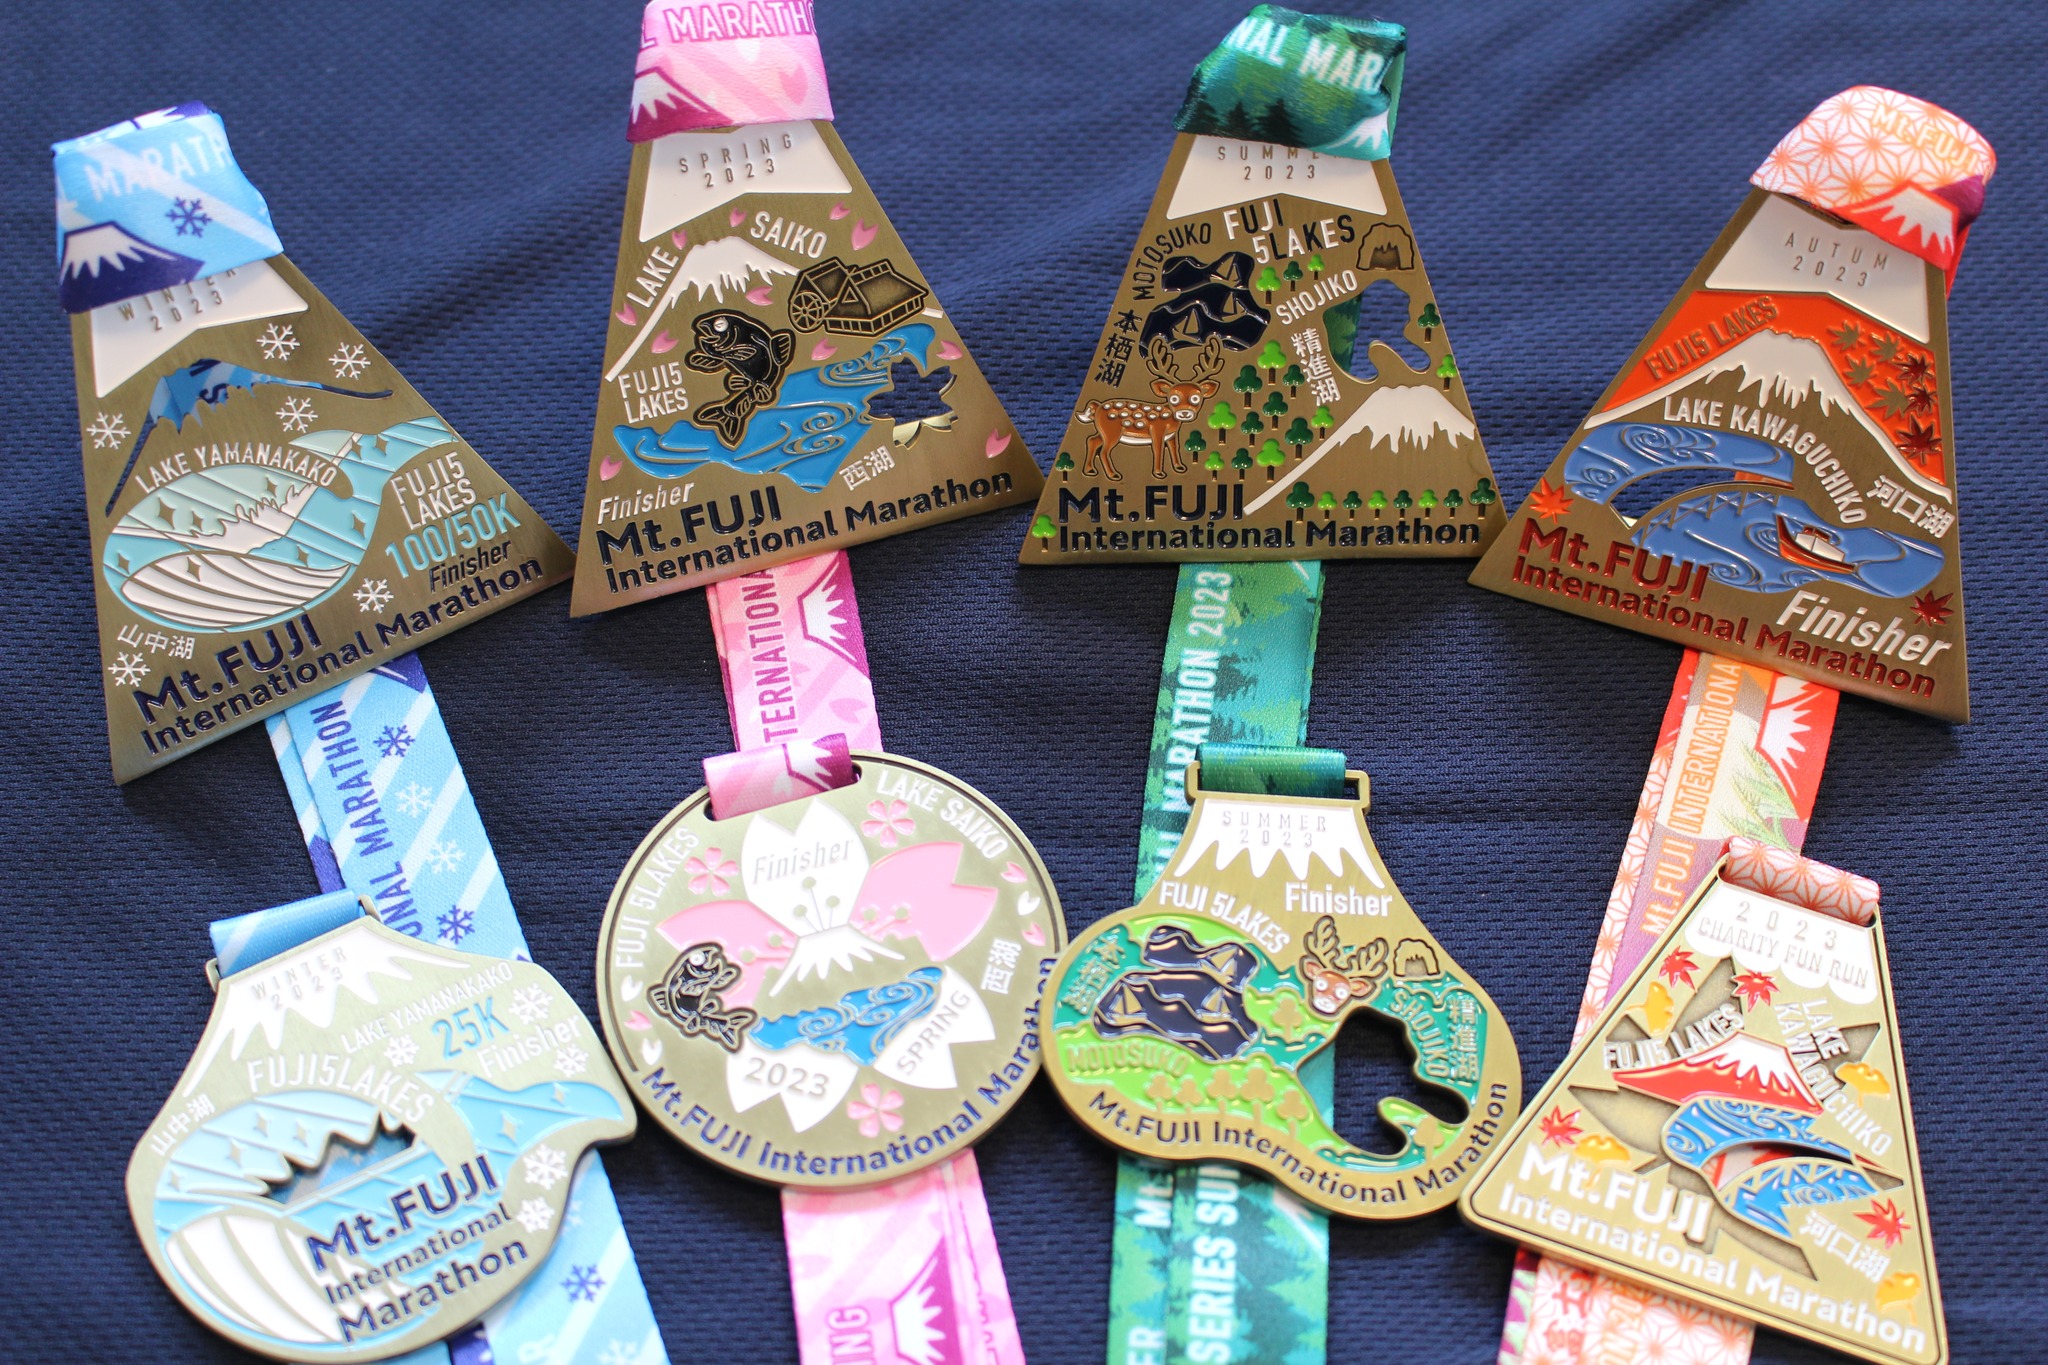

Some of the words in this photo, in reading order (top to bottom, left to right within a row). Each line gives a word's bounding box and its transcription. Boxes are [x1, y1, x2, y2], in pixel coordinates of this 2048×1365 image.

[84, 132, 234, 202] MARATH
[679, 133, 792, 174] SPRING
[1870, 104, 1980, 171] Mt.FUJI
[704, 158, 775, 189] 2023
[1244, 165, 1316, 181] 2023
[1223, 198, 1284, 240] FUJI
[1252, 214, 1356, 264] 5LAKES
[1784, 232, 1889, 271] AUTUM
[627, 245, 680, 308] LAKE
[750, 211, 828, 259] SAIKO
[1132, 222, 1212, 301] MOTOSUKO
[1793, 256, 1869, 287] 2023
[150, 290, 223, 332] 2023
[1275, 269, 1358, 326] SHOJIKO
[1708, 295, 1779, 346] LAKES
[1094, 309, 1143, 389] 本栖湖
[1290, 327, 1342, 407] 精進湖
[624, 387, 690, 425] LAKES
[135, 452, 191, 494] LAKE
[194, 442, 338, 488] YAMANAKAKO
[838, 445, 896, 491] 西湖
[1663, 395, 1724, 428] LAKE
[1729, 404, 1868, 524] KAWAGUCHIKO
[385, 492, 522, 579] 100/50K
[400, 478, 476, 531] LAKES
[596, 485, 782, 566] Mt.FUJI
[597, 481, 694, 525] Finisher
[605, 510, 838, 593] International
[844, 471, 1013, 532] Marathon
[1058, 483, 1244, 524] Mt.FUJI
[1060, 520, 1296, 552] International
[1305, 517, 1481, 548] Marathon
[1866, 474, 1956, 539] 河口湖
[429, 538, 512, 594] Finisher
[1517, 516, 1710, 603] Mt.FUJI
[1186, 570, 1233, 639] 2023
[1512, 555, 1750, 646] International
[1754, 623, 1936, 699] Marathon
[1775, 589, 1953, 667] Finisher
[117, 623, 196, 660] 山中湖
[132, 612, 322, 726] Mt.FUJI
[140, 630, 374, 756] International
[375, 559, 544, 648] Marathon
[310, 700, 394, 857] MARATHON
[876, 769, 943, 812] LAKE
[939, 796, 1009, 860] SAIKO
[1222, 811, 1327, 832] SUMMER
[1240, 829, 1313, 848] 2023
[628, 825, 700, 913] 5LAKES
[753, 838, 855, 886] Finisher
[1159, 880, 1209, 912] FUJI
[1210, 891, 1291, 955] 5LAKES
[1285, 881, 1393, 917] Finisher
[1736, 900, 1838, 950] 2023
[251, 946, 348, 1000] WINTER
[615, 914, 650, 969] FUJI
[980, 937, 1022, 995] 西湖
[1697, 915, 1781, 960] CHARITY
[1784, 943, 1824, 976] FUN
[1827, 959, 1872, 991] RUN
[272, 966, 344, 1012] 2023
[340, 1015, 392, 1055] LAKE
[389, 960, 514, 1031] YAMANAKAKO
[430, 996, 510, 1061] 25K
[477, 1013, 582, 1080] Finisher
[896, 989, 970, 1076] SPRING
[1067, 1040, 1191, 1078] MOTOSUKO
[1389, 989, 1451, 1079] SHOJIKO
[1669, 1003, 1745, 1058] LAKES
[1801, 997, 1852, 1061] LAKE
[745, 1056, 830, 1098] 2023
[1773, 1002, 1894, 1158] KAWAGUCHIKO
[151, 1092, 218, 1157] 山中湖
[641, 1066, 752, 1149] Mt.FUJI
[757, 1100, 983, 1176] International
[1088, 1090, 1201, 1143] Mt.FUJI
[1214, 1120, 1407, 1205] International
[1413, 1082, 1508, 1197] Marathon
[306, 1154, 498, 1273] Mt.FUJI
[1517, 1143, 1716, 1243] Mt.FUJI
[324, 1201, 512, 1305] International
[1498, 1180, 1739, 1292] International
[1744, 1265, 1927, 1355] Marathon
[1800, 1209, 1893, 1285] 河口湖
[336, 1239, 530, 1343] Marathon
[1183, 1235, 1238, 1365] SERIES
